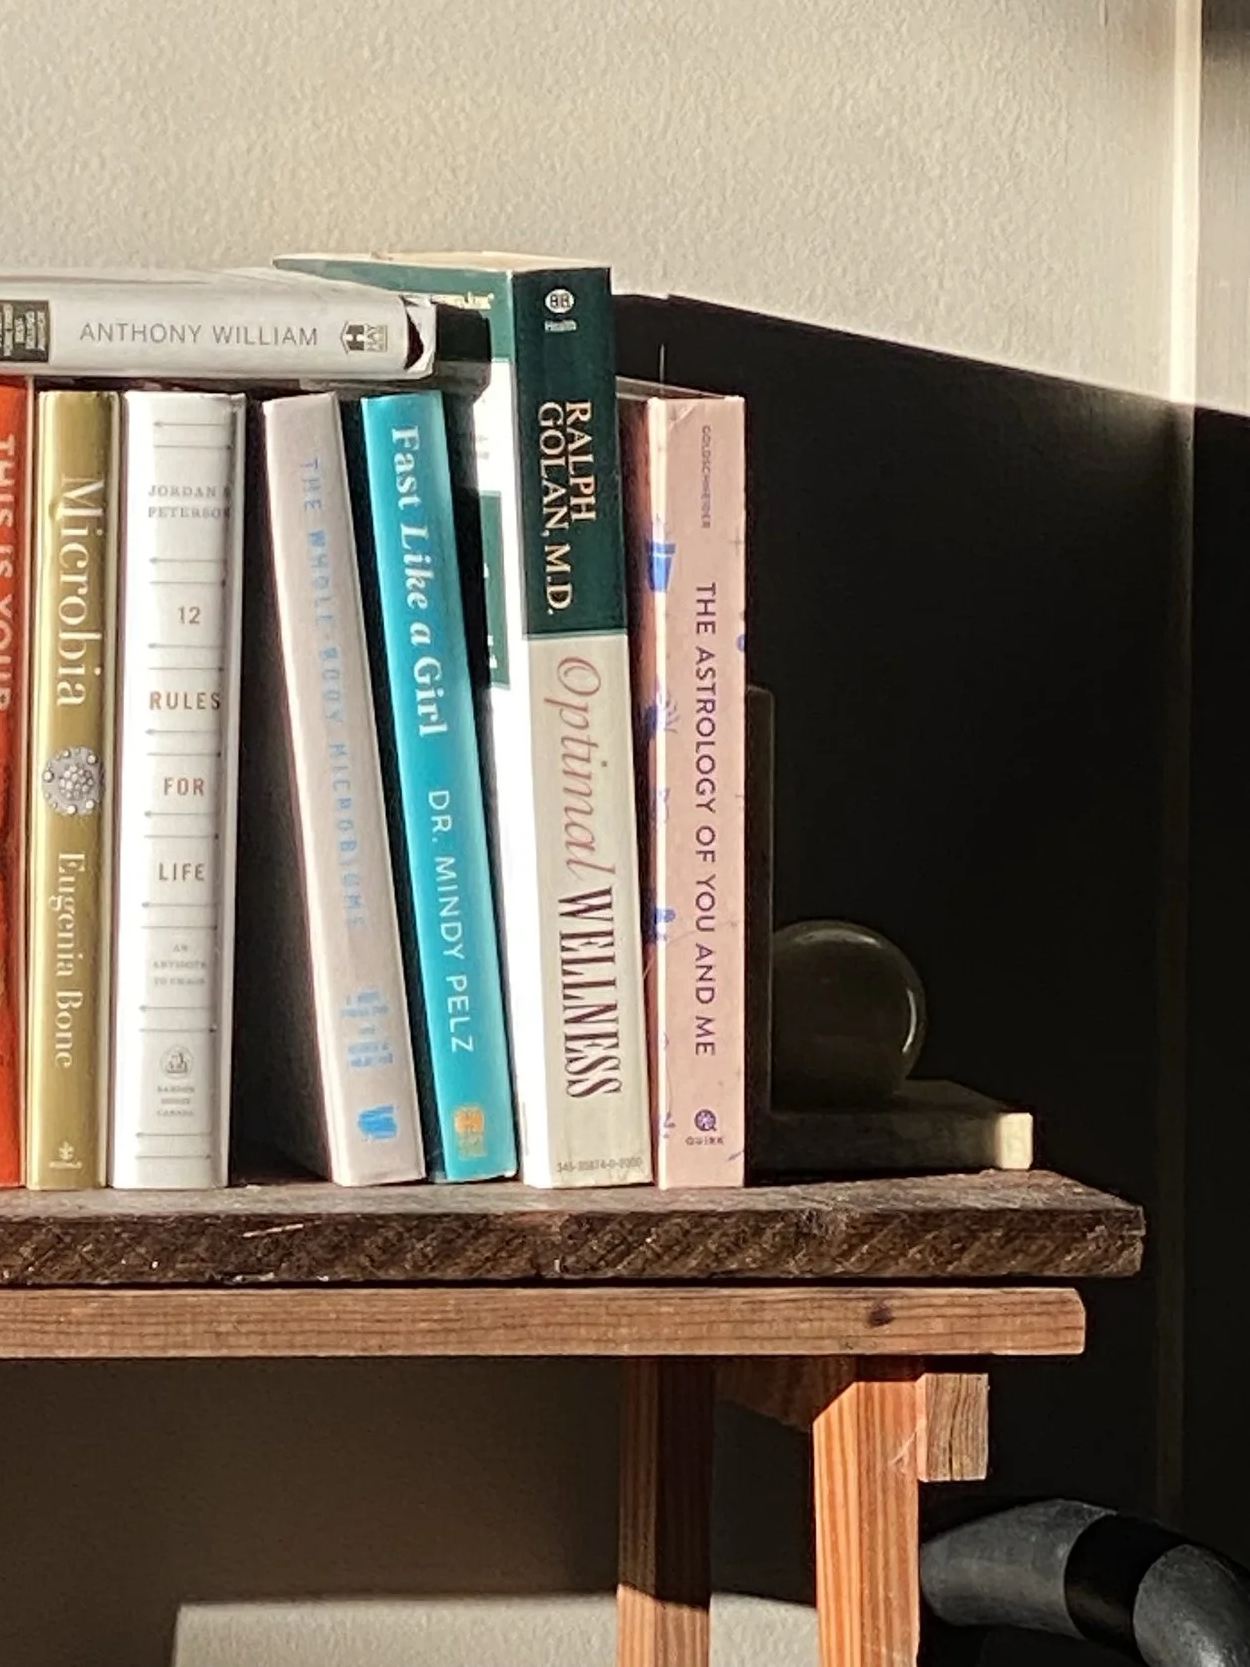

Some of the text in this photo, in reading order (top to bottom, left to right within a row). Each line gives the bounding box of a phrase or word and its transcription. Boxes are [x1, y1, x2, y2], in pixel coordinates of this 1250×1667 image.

[79, 321, 319, 347] ANTHONY WILLIAM
[301, 456, 322, 512] THE
[537, 401, 575, 616] GOLAN, M.D.
[565, 400, 597, 522] RALPH
[57, 471, 106, 707] Microbia
[177, 606, 201, 625] 12
[391, 425, 448, 737] Fast Like a Girl
[149, 691, 222, 711] RULES
[163, 777, 204, 798] FOR
[543, 656, 616, 880] Optimal
[158, 863, 206, 882] LIFE
[428, 790, 474, 1054] DR. MINDY PELZ
[695, 581, 717, 1056] THE ASTROLOGY OF YOU AND ME
[48, 850, 87, 1068] Eugenia Bone
[558, 886, 623, 1099] WELLNESS
